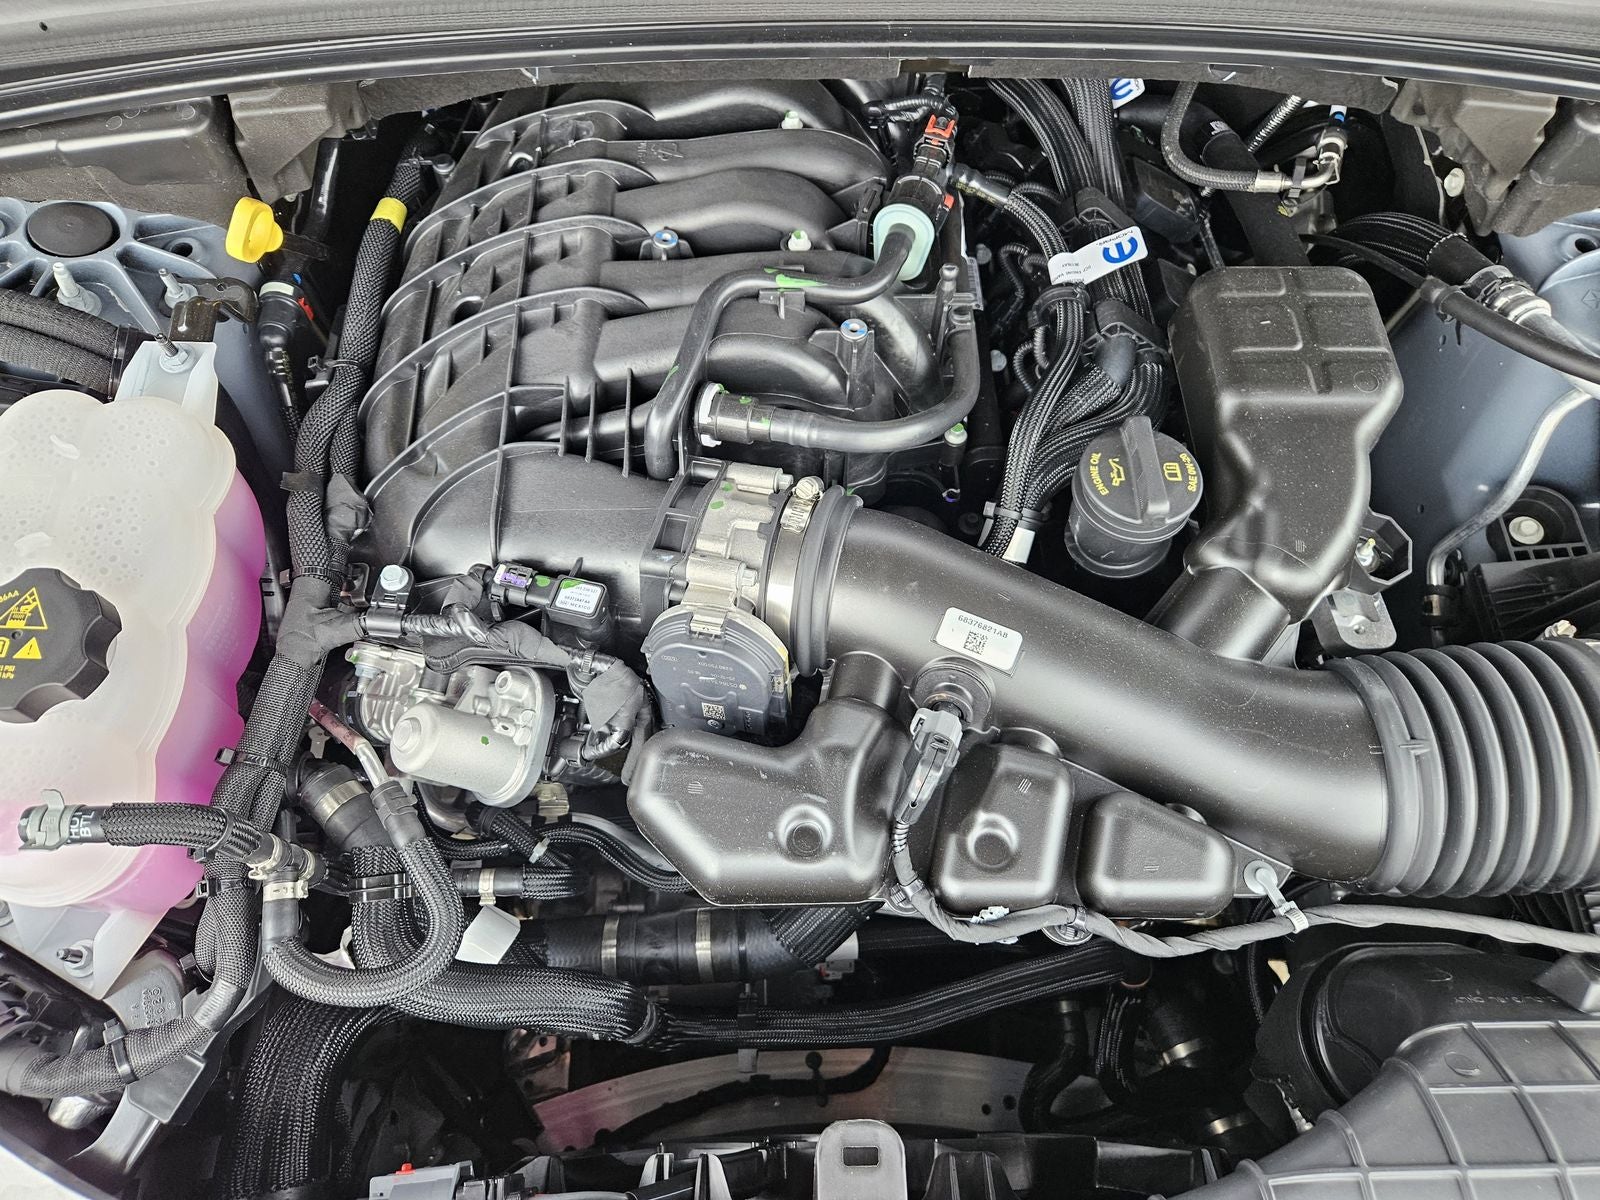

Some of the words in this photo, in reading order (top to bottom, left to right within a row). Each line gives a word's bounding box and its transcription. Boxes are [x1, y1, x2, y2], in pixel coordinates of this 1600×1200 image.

[1090, 452, 1102, 464] OIL
[1090, 465, 1109, 496] ENGINE
[1187, 475, 1198, 492] SAE
[958, 615, 1008, 638] 68376821AB
[80, 811, 95, 837] BTL
